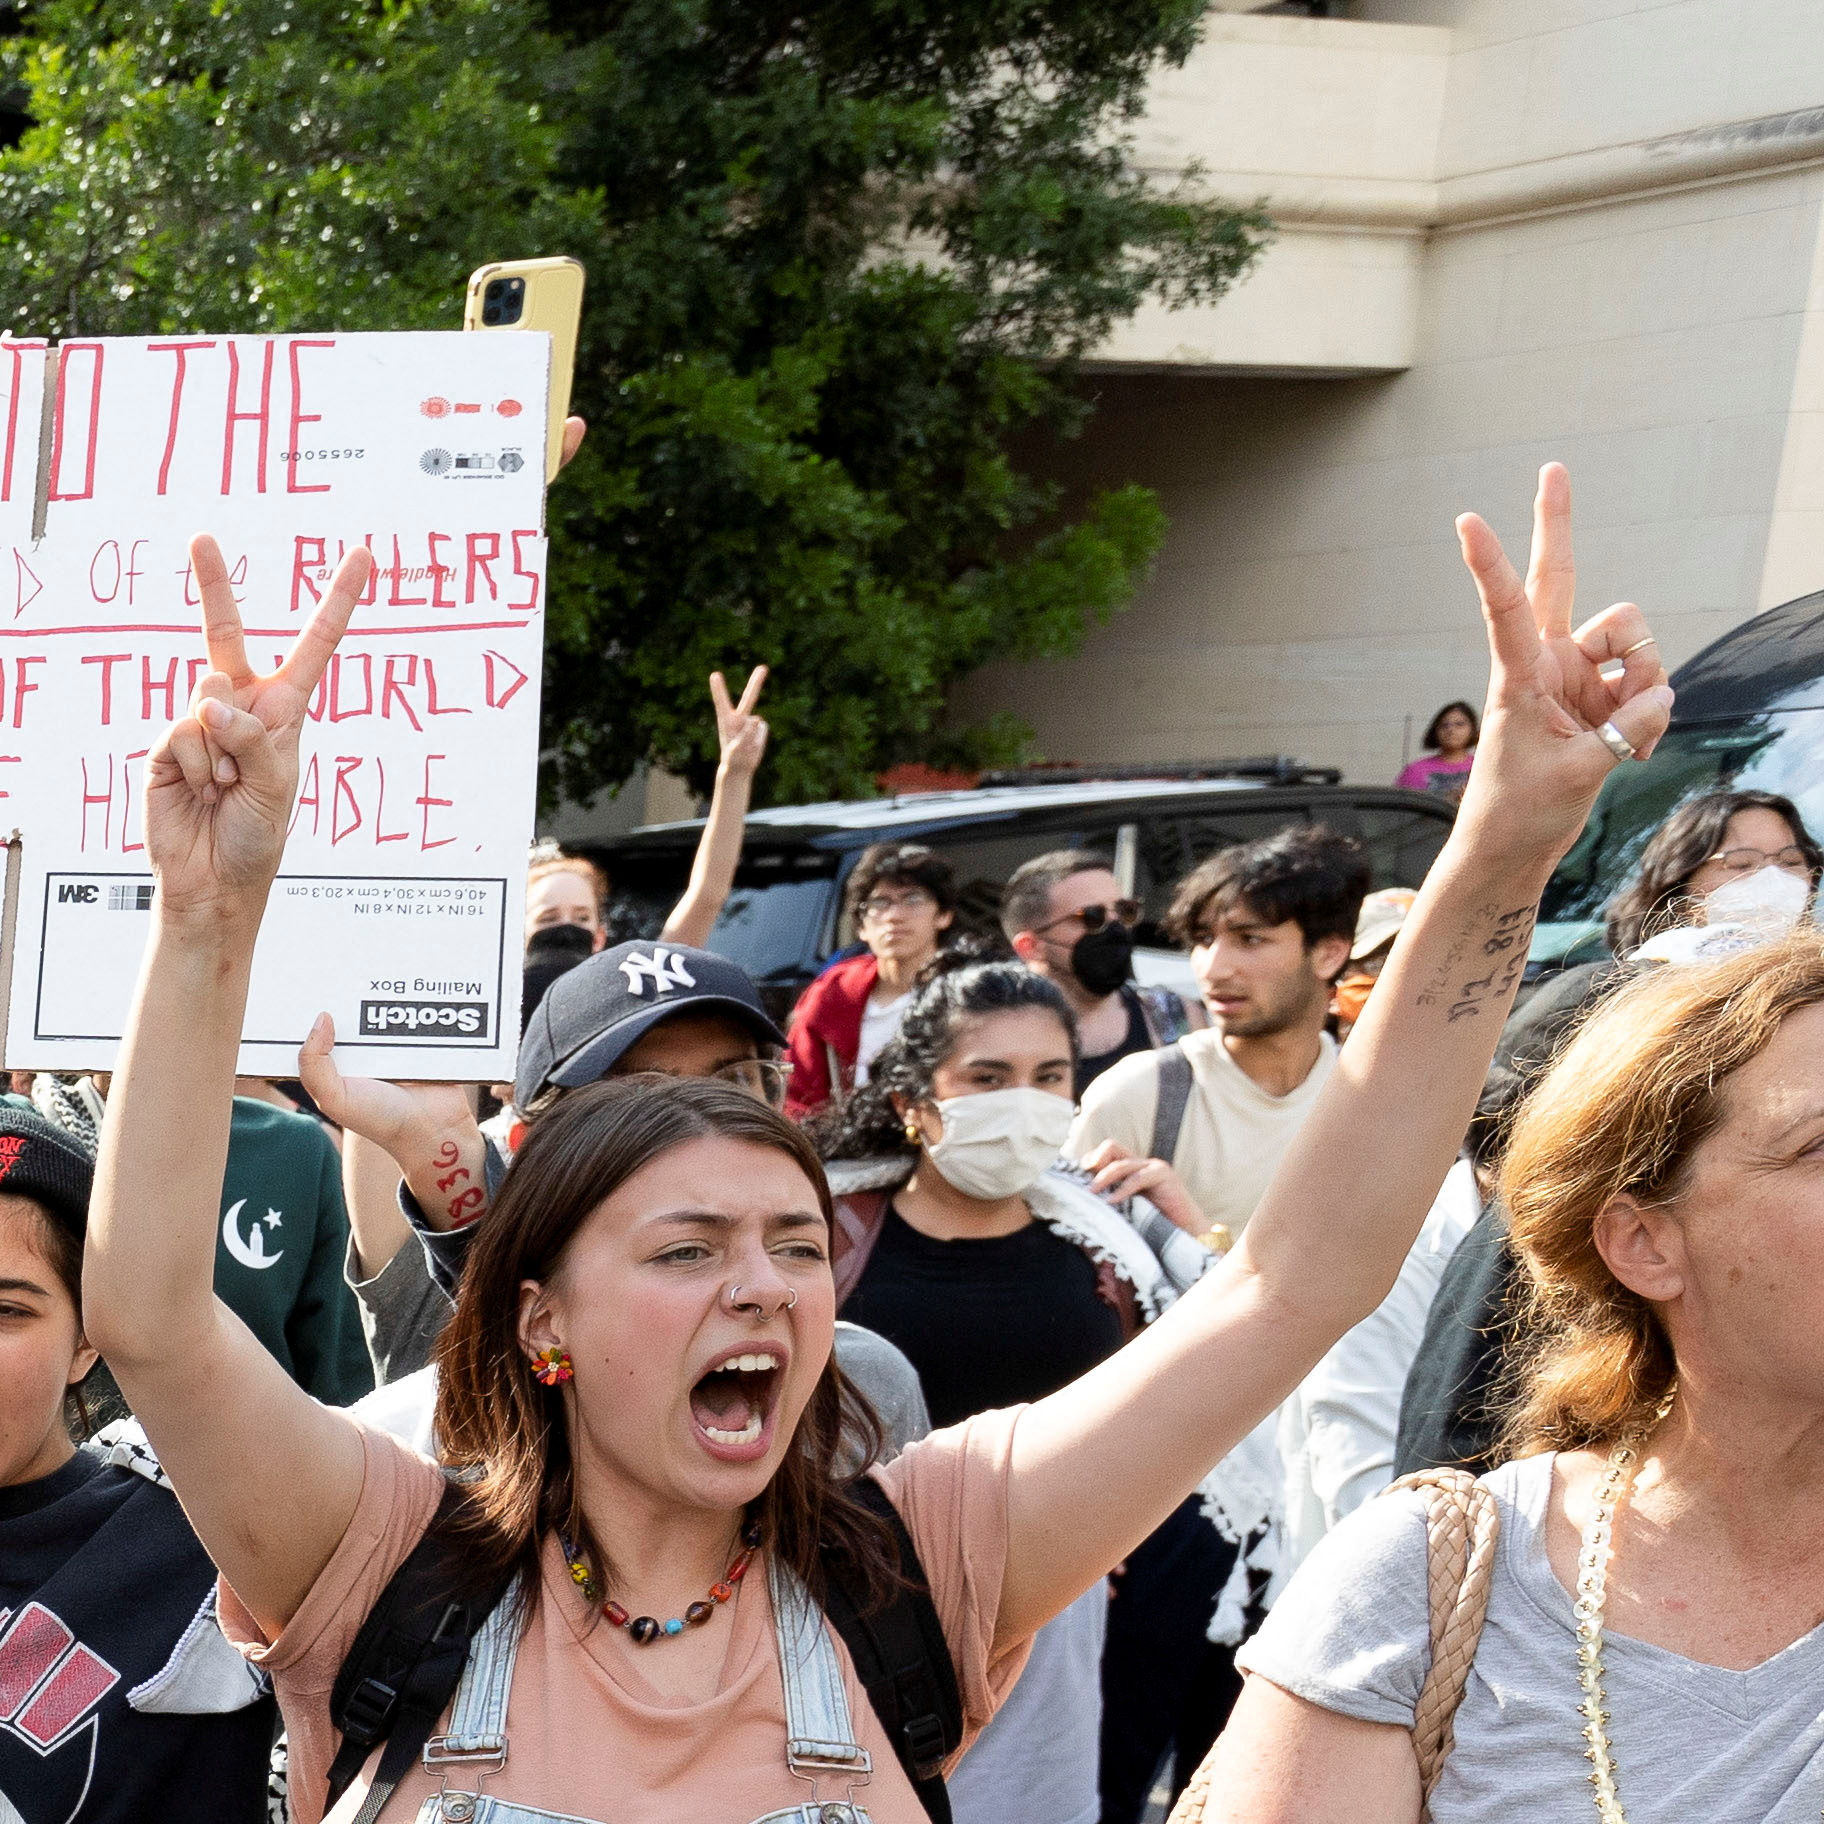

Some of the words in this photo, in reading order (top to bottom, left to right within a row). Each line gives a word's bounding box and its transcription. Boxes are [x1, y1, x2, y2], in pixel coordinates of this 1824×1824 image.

[148, 340, 336, 495] THE
[58, 884, 100, 905] 3M
[355, 904, 369, 913] IN
[374, 904, 381, 913] 8
[397, 905, 411, 914] IN
[416, 905, 431, 914] 12
[449, 906, 463, 915] IN
[468, 905, 483, 915] 16
[371, 981, 405, 994] Box
[414, 978, 481, 995] Mailing
[365, 1006, 482, 1033] Scotch
